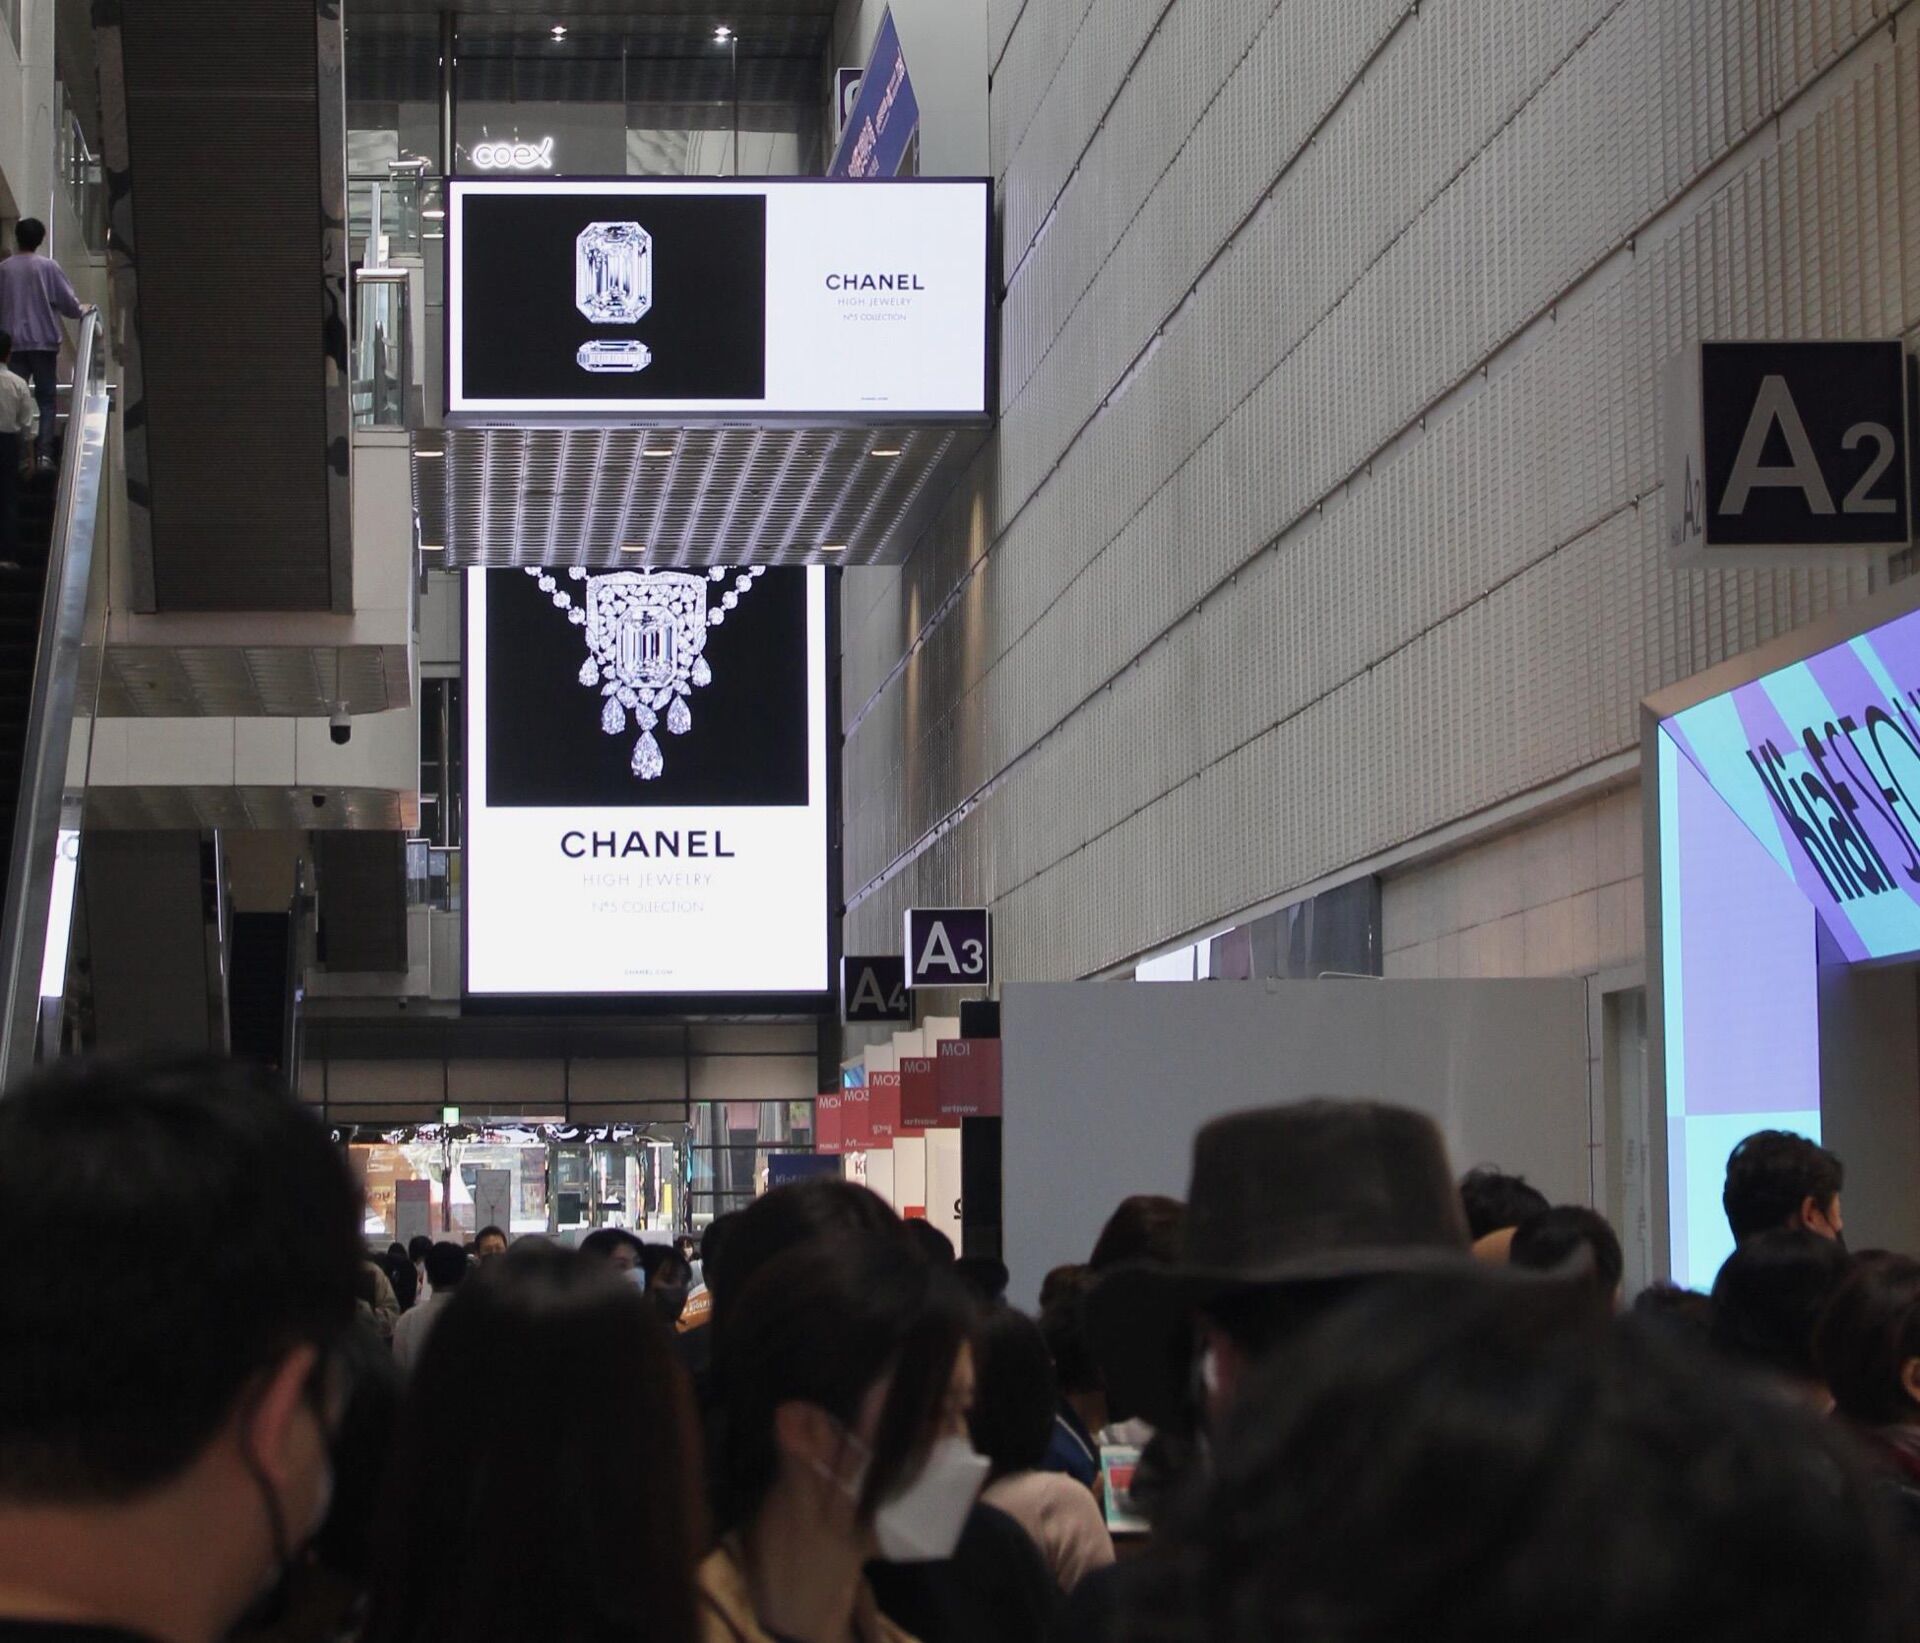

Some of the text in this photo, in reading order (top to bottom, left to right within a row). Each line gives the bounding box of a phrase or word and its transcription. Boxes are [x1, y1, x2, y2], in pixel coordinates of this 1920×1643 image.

[474, 138, 553, 169] coex
[825, 274, 925, 291] CHANEL
[838, 296, 912, 307] HIGH JEWELRY
[860, 312, 907, 321] COLLECTION
[1718, 374, 1897, 515] A2
[561, 830, 736, 858] CHANEL
[583, 872, 713, 889] HIGH JEWELRY
[622, 900, 704, 914] COLLECTION
[916, 920, 984, 975] A3
[850, 966, 908, 1013] A4
